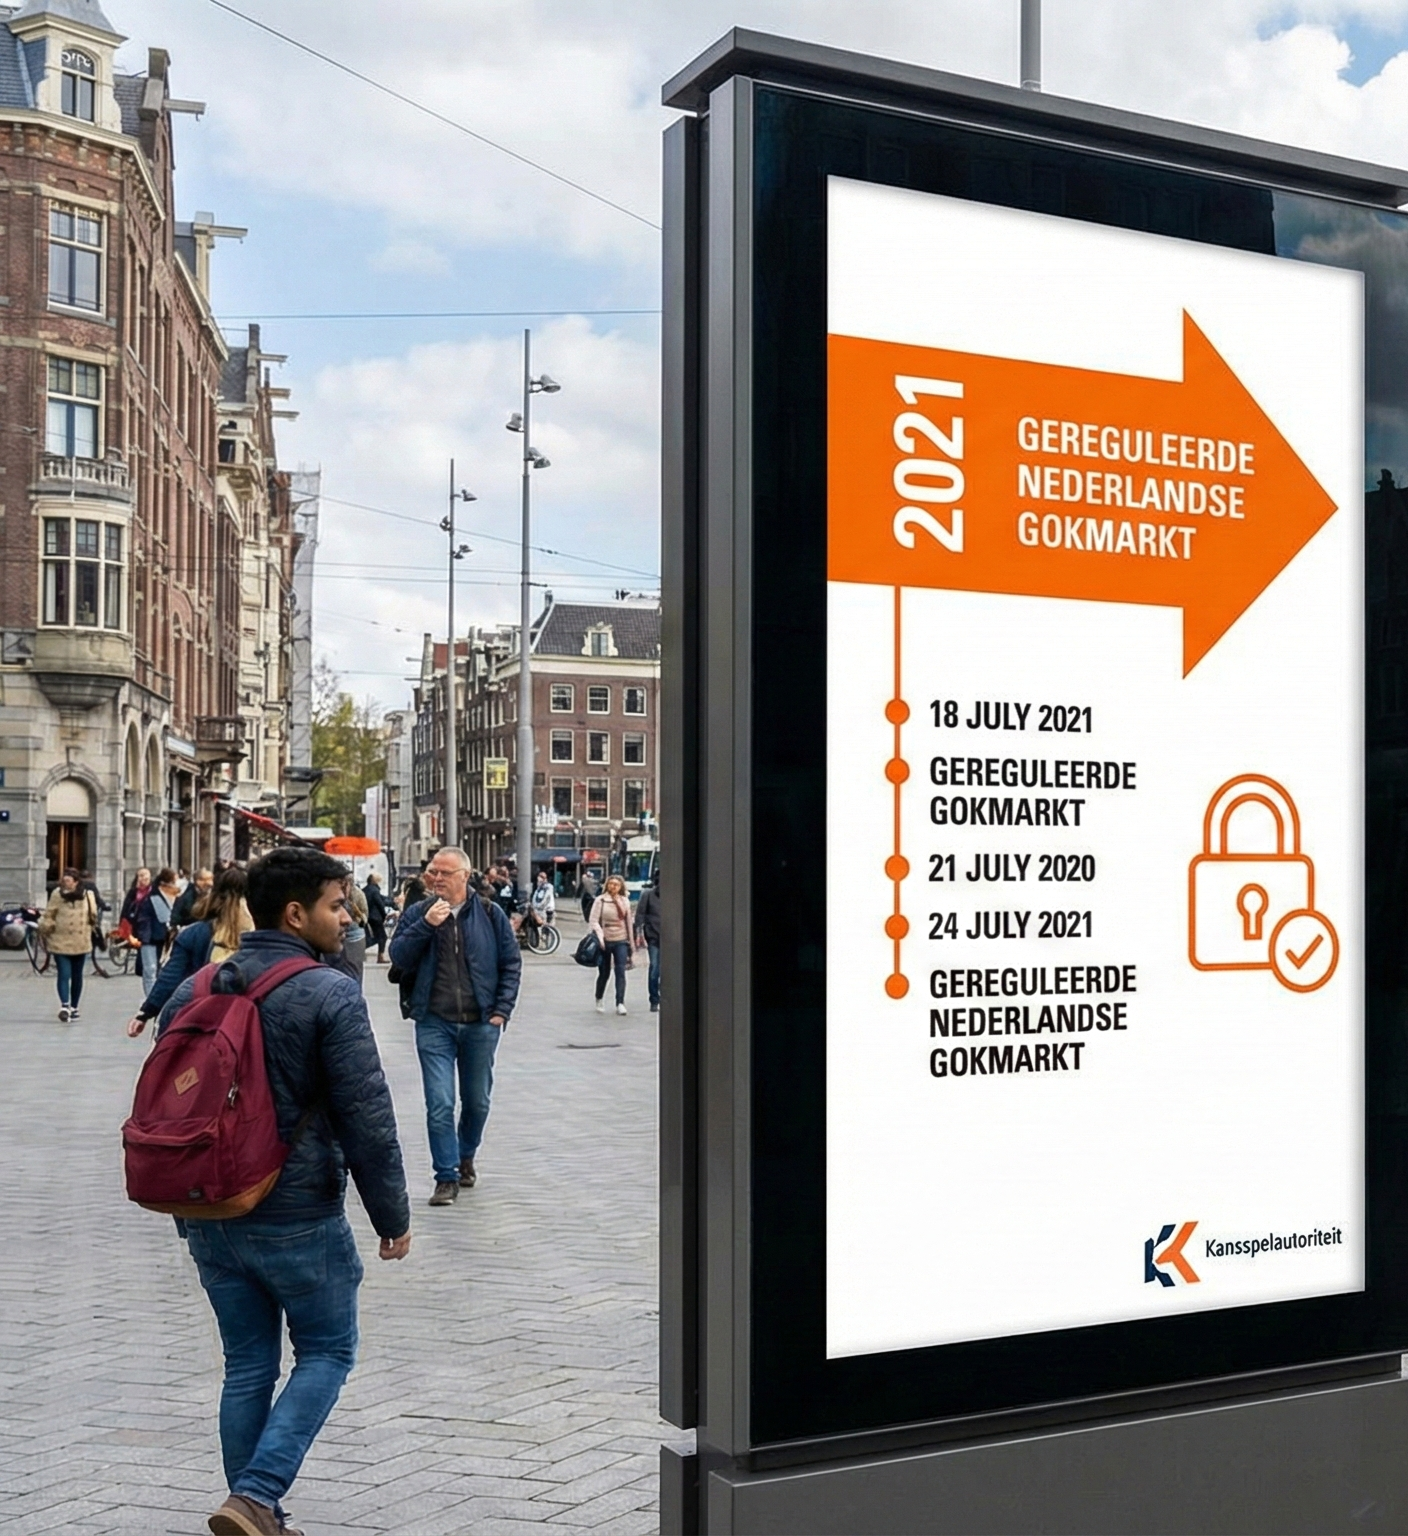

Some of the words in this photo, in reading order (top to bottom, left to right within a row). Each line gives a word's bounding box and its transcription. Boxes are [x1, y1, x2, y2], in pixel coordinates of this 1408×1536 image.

[1018, 416, 1255, 475] GEREGULEERDE
[893, 374, 965, 553] 2021
[1018, 464, 1245, 519] NEDERLANDSE
[1018, 511, 1197, 559] GOKMARKT
[930, 699, 959, 729] 18
[966, 700, 1032, 731] JULY
[1038, 704, 1092, 734] 2021
[930, 756, 1137, 790] GEREGULEERDE
[930, 795, 1086, 827] GOKMARKT
[928, 853, 956, 882] 21
[965, 853, 1032, 882] JULY
[1038, 853, 1096, 882] 2020
[928, 911, 959, 940] 24
[965, 910, 1032, 940] JULY
[1038, 910, 1092, 939] 2021
[930, 964, 1137, 999] GEREGULEERDE
[930, 1002, 1128, 1038] NEDERLANDSE
[929, 1041, 1086, 1078] GOKMARKT
[1205, 1227, 1343, 1258] Kansspelautoriteit
